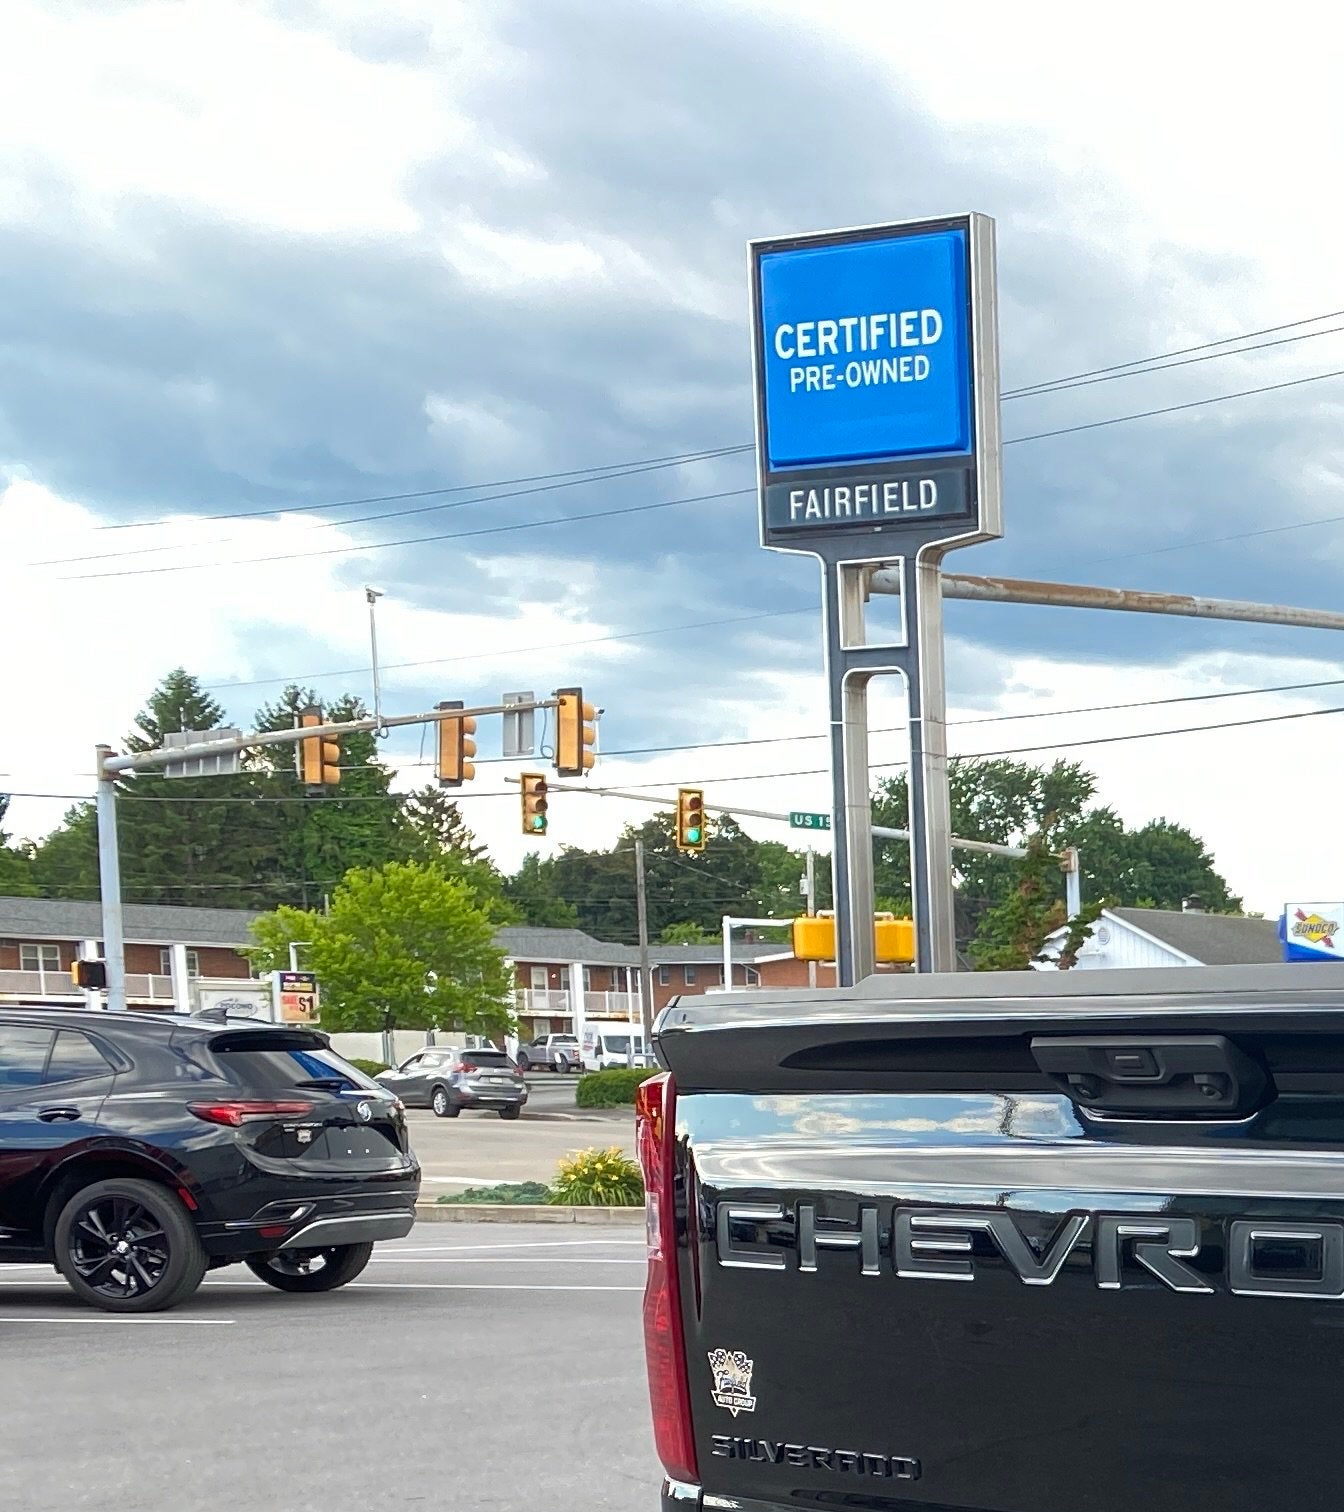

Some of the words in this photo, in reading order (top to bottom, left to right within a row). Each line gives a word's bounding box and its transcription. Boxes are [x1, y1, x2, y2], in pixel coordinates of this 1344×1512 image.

[775, 309, 943, 360] CERTIFIED
[790, 355, 931, 392] PRE-OWNED
[789, 479, 938, 520] FAIRFIELD
[794, 814, 813, 826] US
[1295, 921, 1337, 936] SUNOCO
[712, 1434, 923, 1480] SILVERADO
